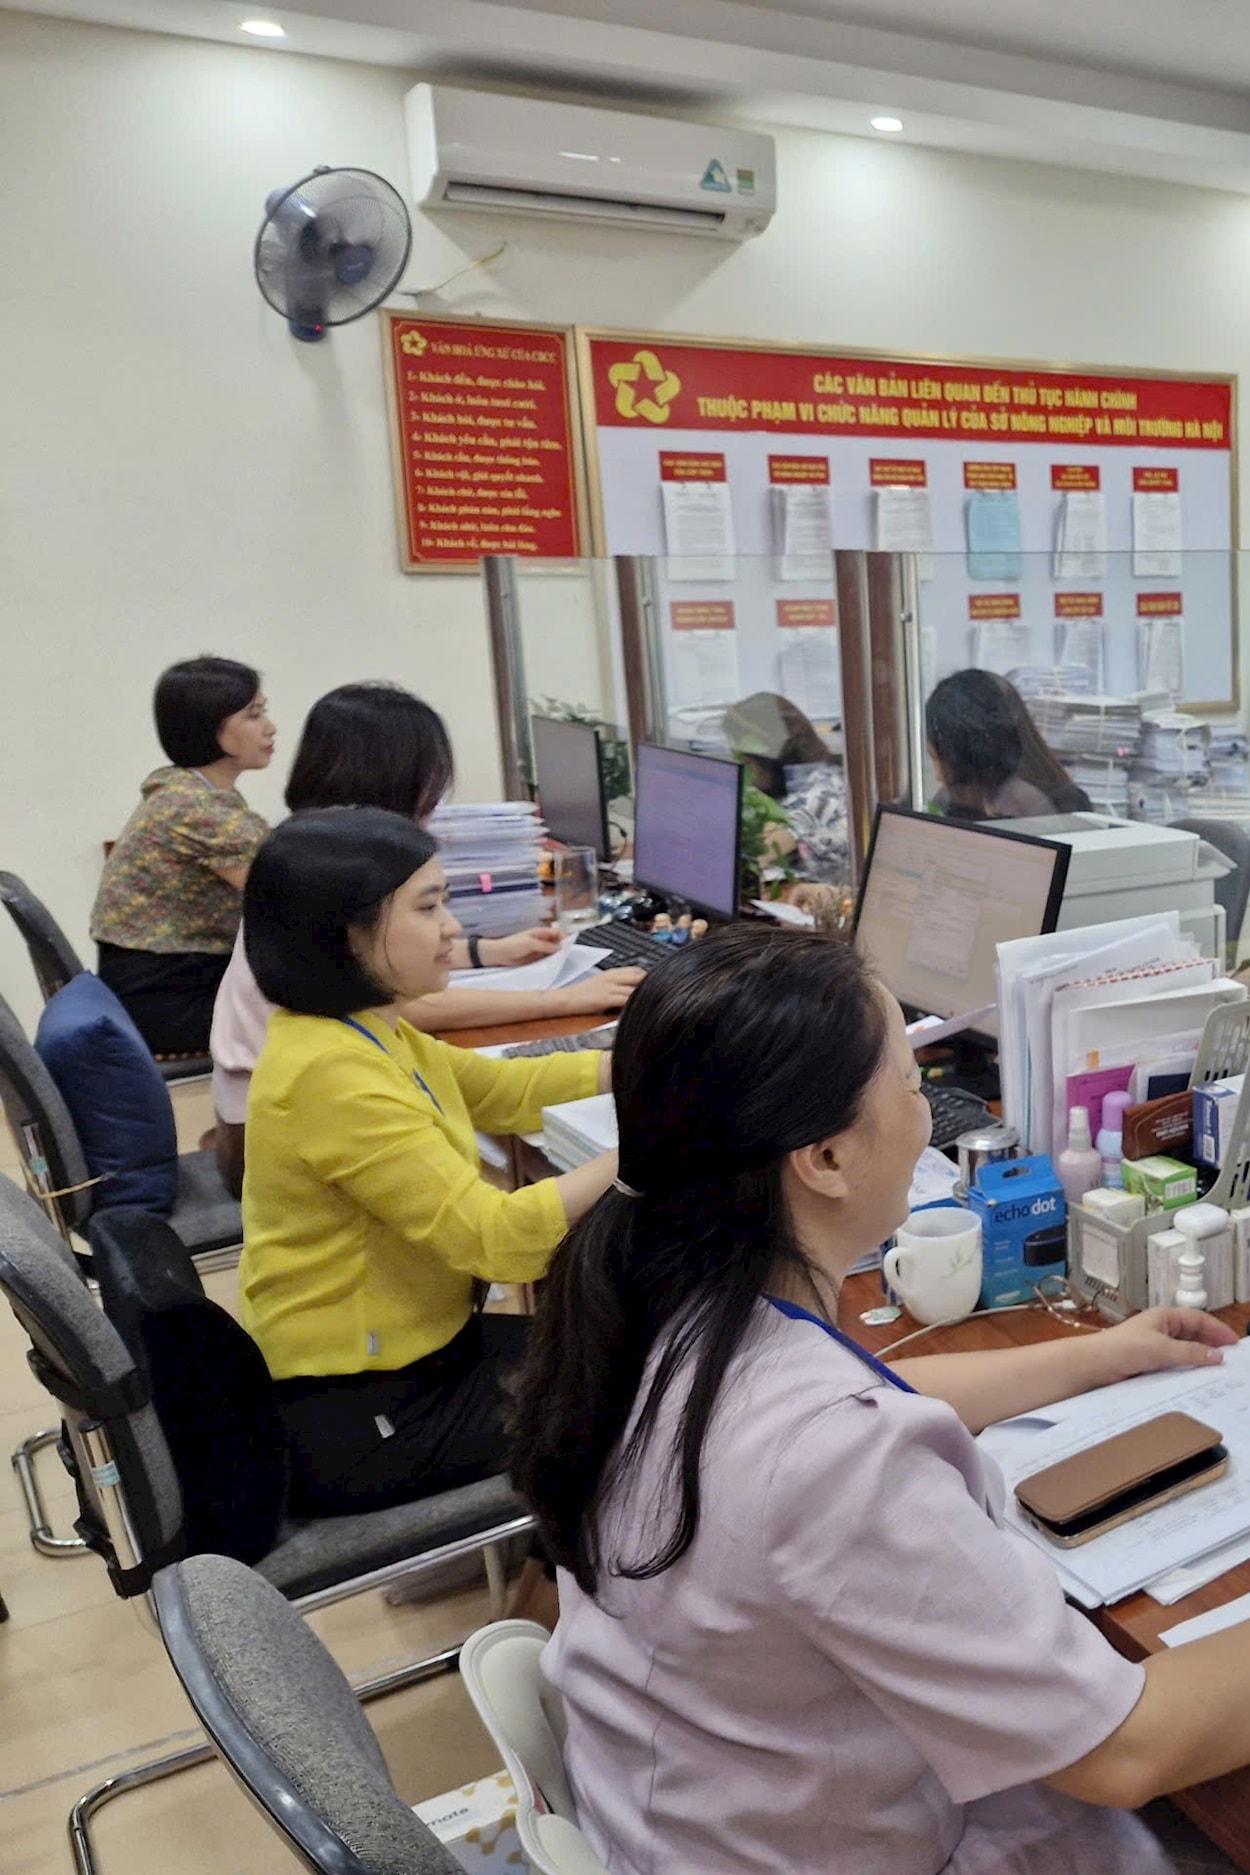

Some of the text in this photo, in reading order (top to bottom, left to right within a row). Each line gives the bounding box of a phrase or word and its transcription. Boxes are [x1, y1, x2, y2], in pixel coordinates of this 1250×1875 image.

[813, 372, 1138, 411] CÁC VĂN BẢN LIÊN QUAN ĐẾN THỦ TỤC HÀNH CHÍNH
[697, 395, 1223, 442] THUỘC PHẠM VI CHỨC NĂNG QUẢN LÝ CỦA SỞ NÔNG NGHIỆP VÀ MÔI TRƯỜNG HÀ NỘI
